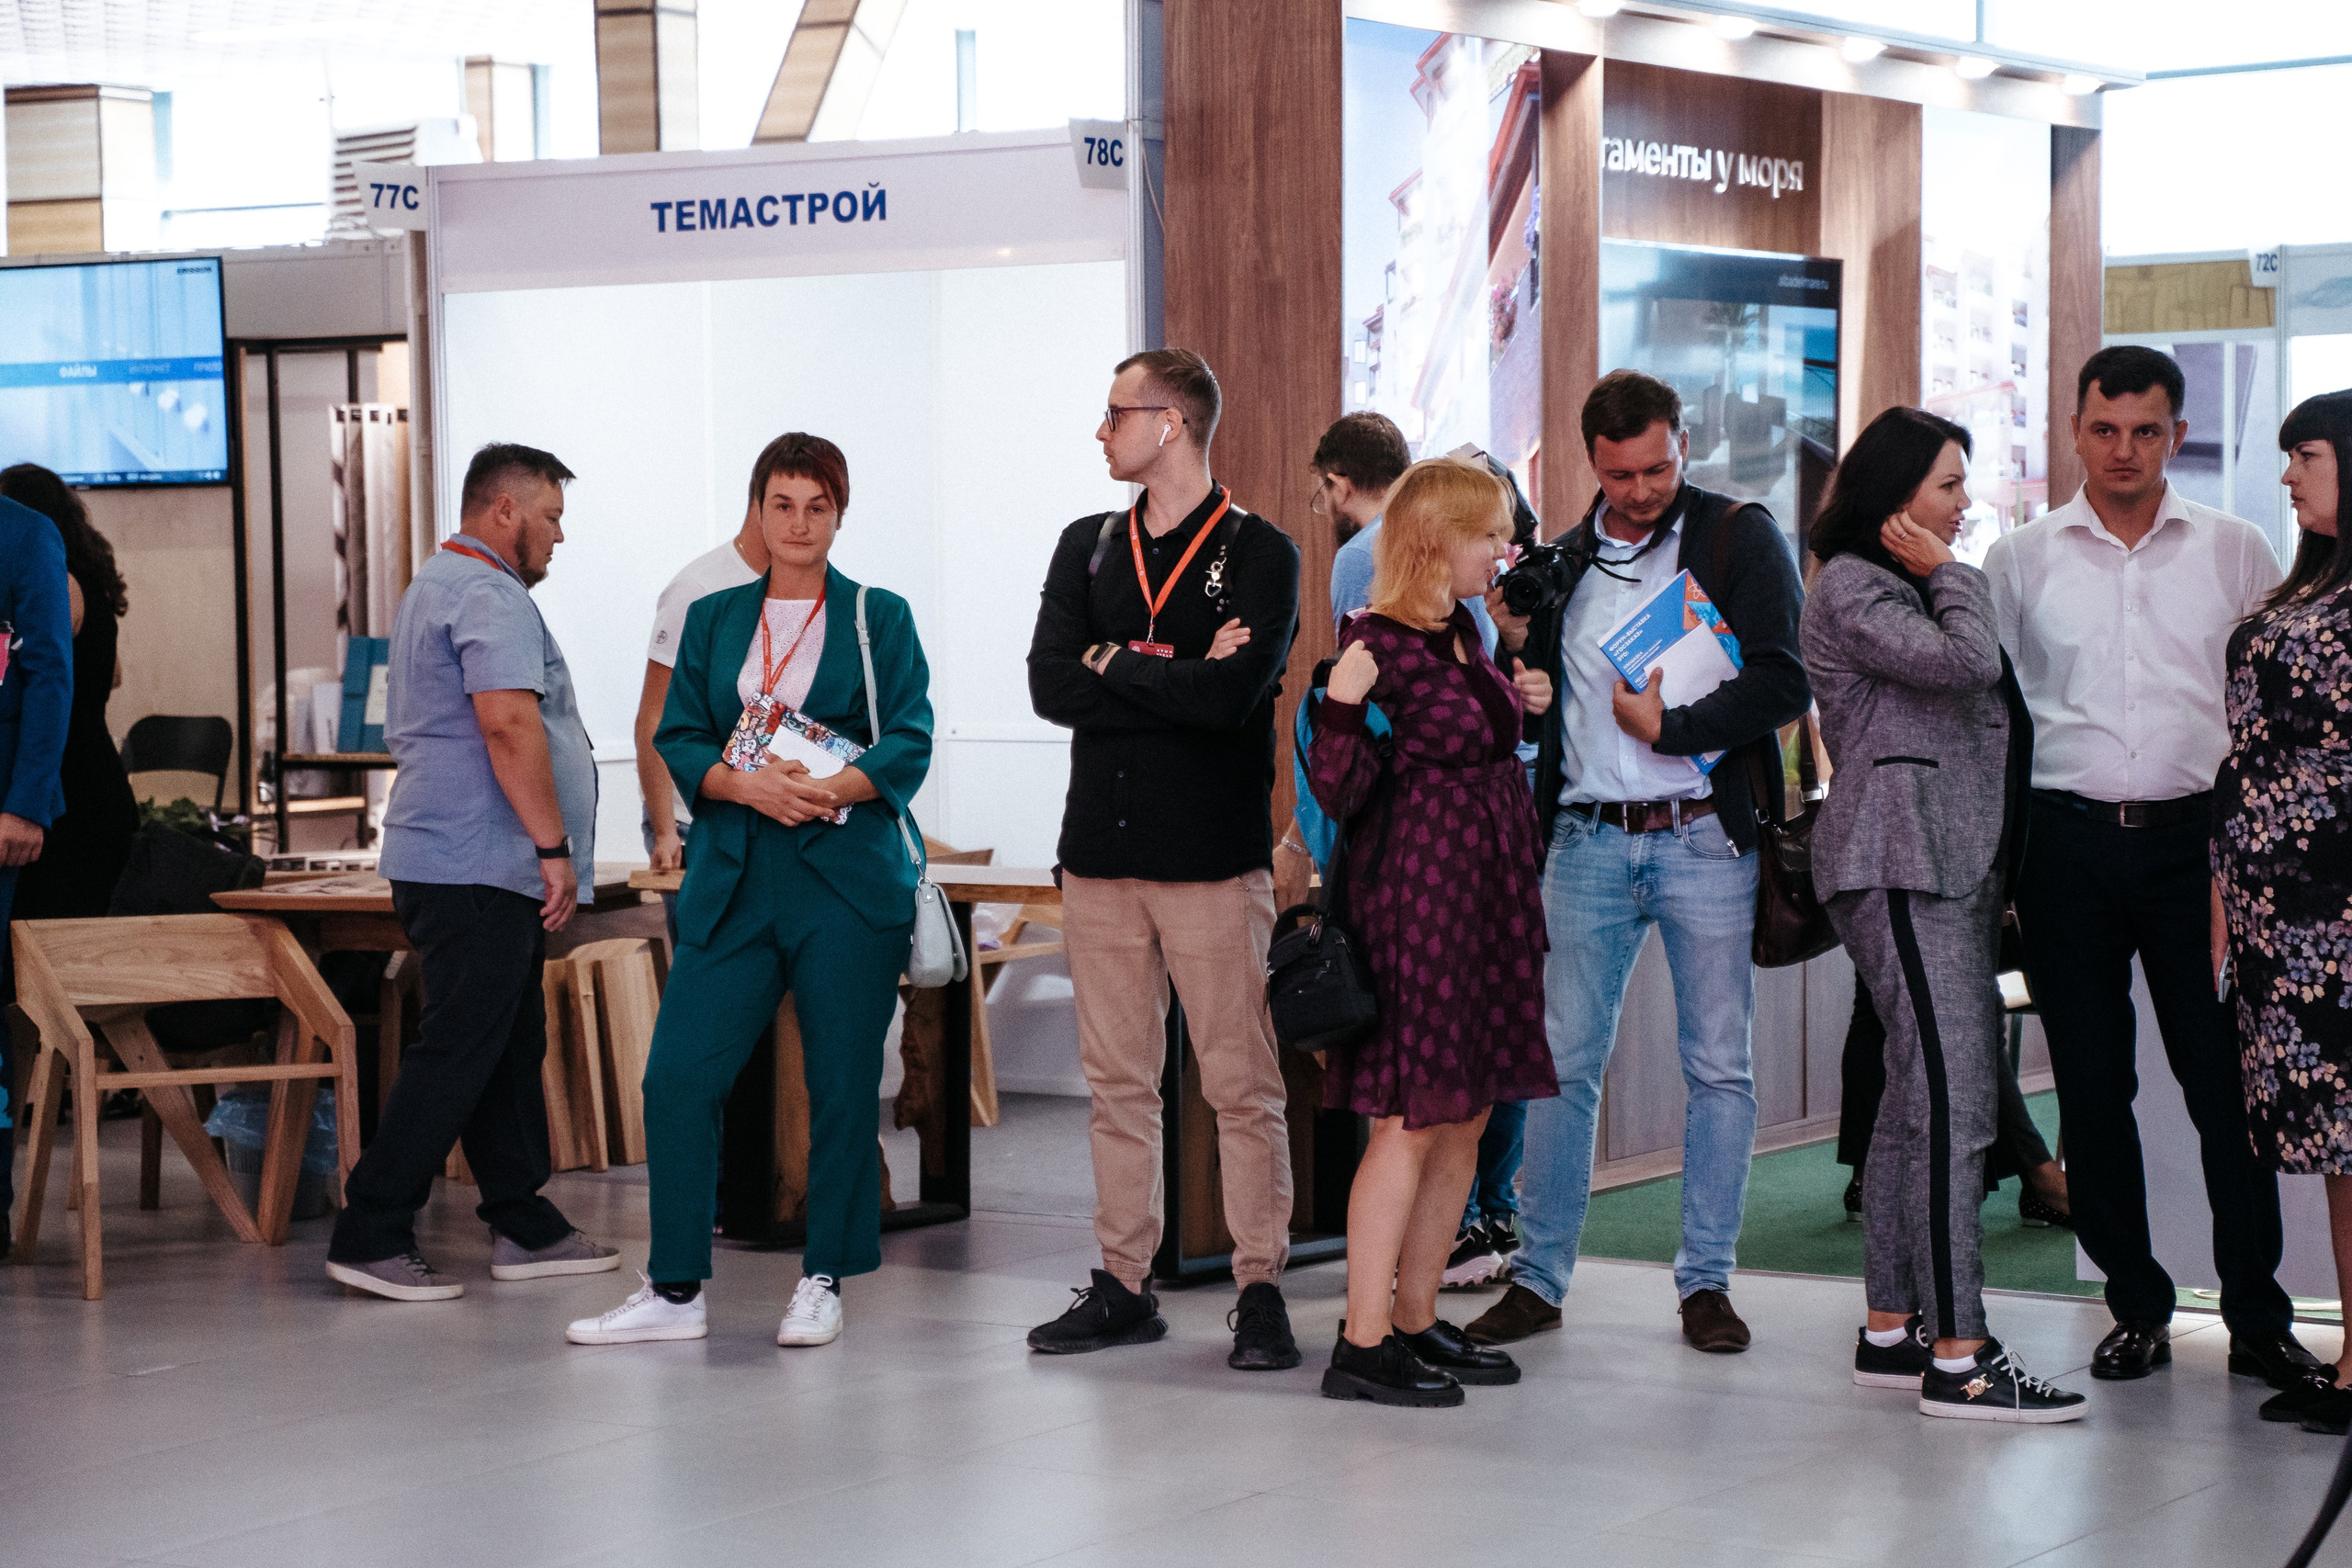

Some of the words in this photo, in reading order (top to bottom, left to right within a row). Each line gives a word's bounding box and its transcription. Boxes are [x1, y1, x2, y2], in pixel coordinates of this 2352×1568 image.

[1714, 150, 1735, 193] у
[1738, 152, 1804, 198] моря
[650, 182, 887, 232] ТЕМАСТРОЙ
